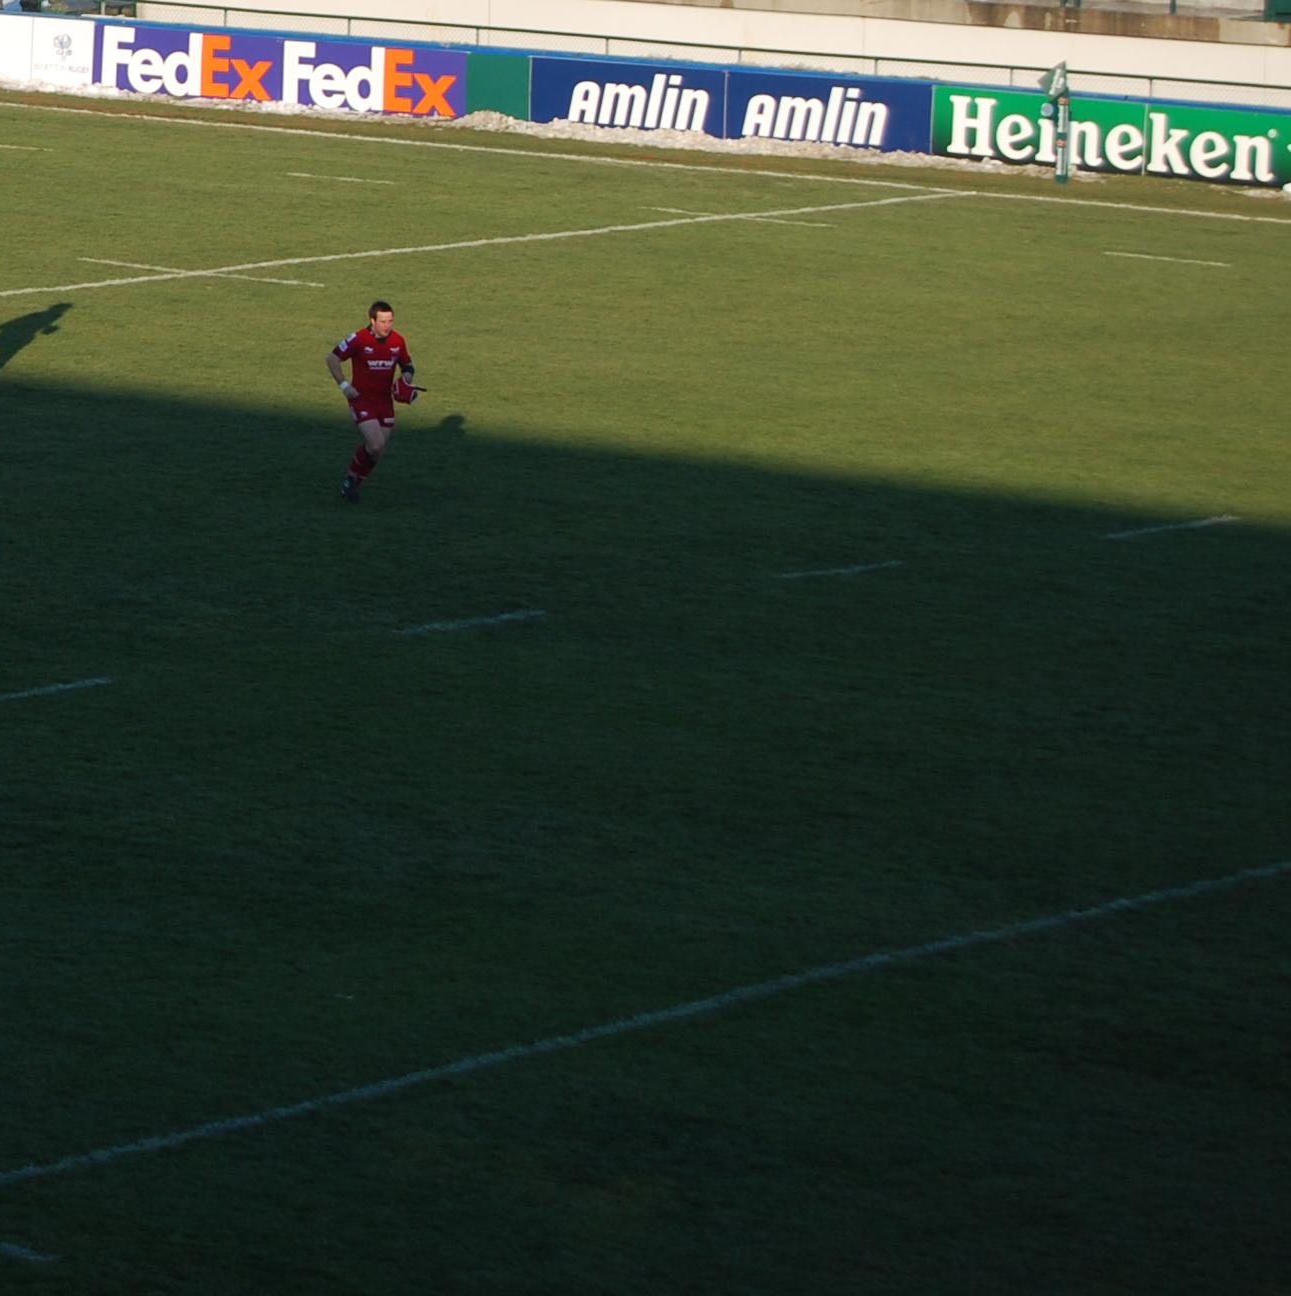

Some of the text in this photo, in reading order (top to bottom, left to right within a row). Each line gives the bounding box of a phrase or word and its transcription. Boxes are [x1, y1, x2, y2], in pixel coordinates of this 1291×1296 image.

[102, 26, 273, 101] FedEx
[283, 40, 456, 117] FedEx
[946, 95, 1276, 183] Heineken
